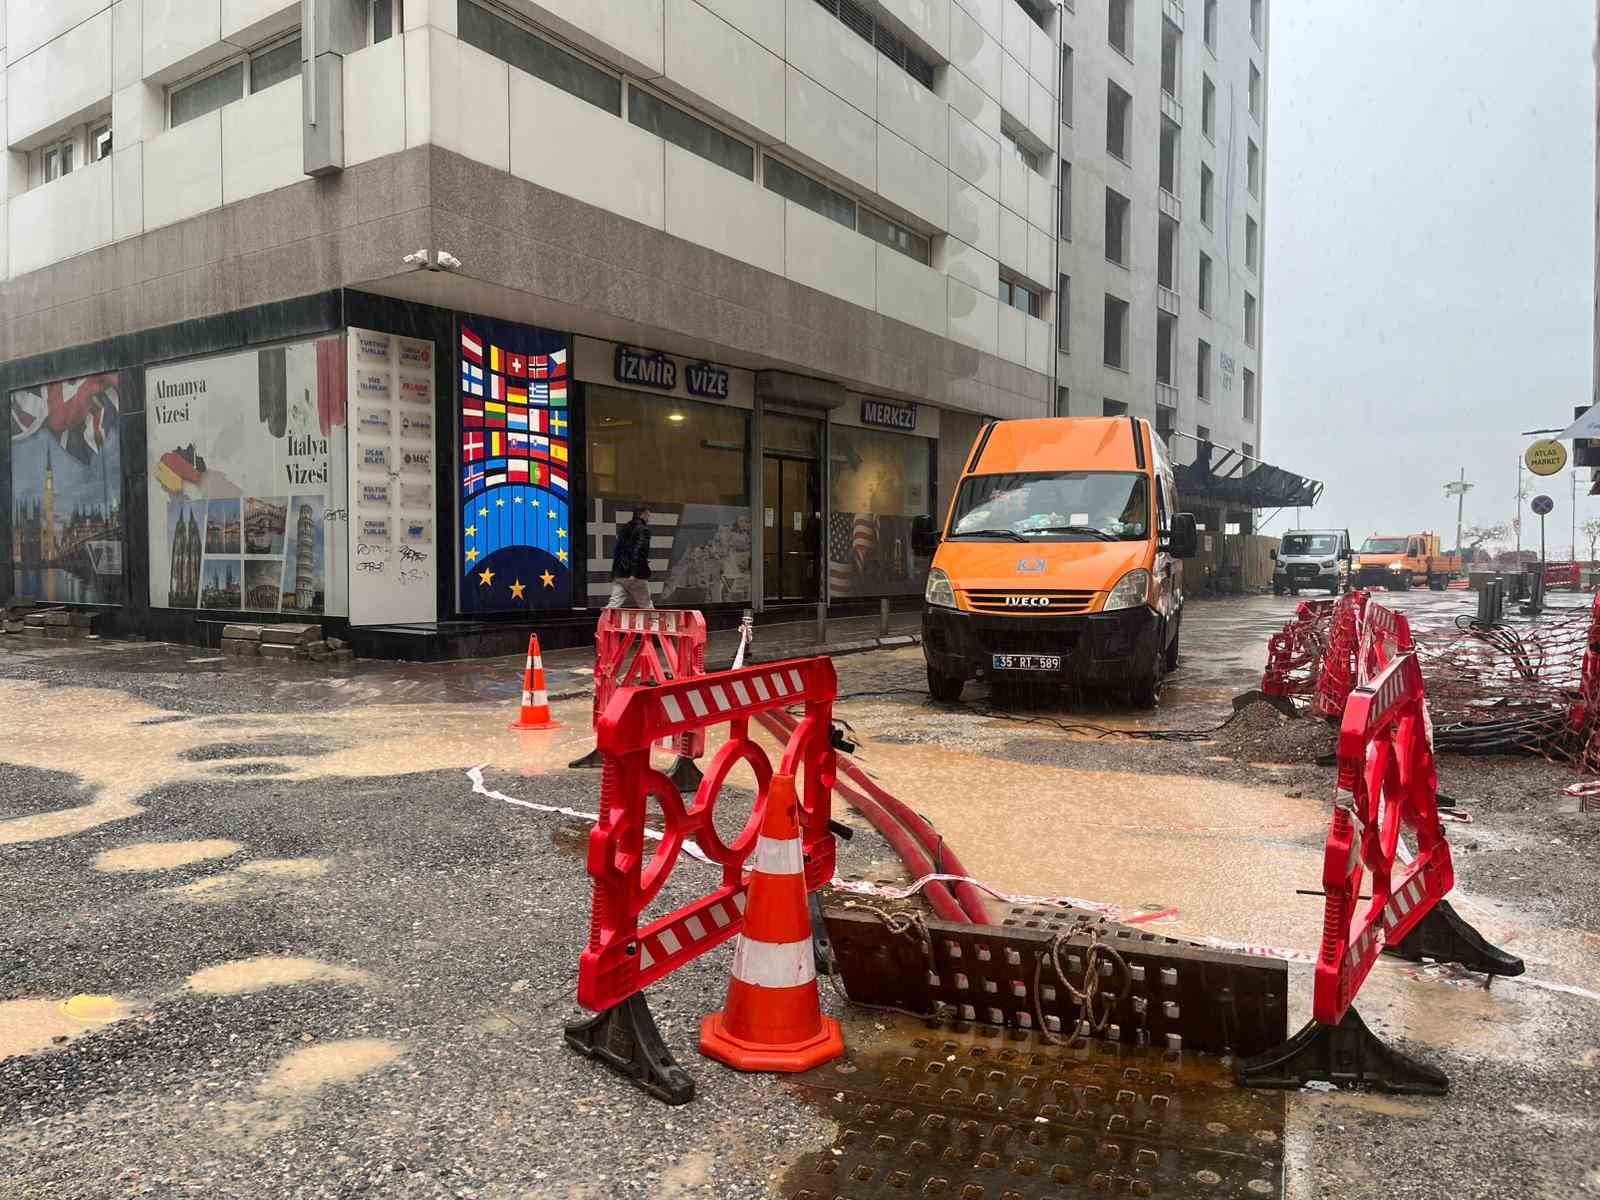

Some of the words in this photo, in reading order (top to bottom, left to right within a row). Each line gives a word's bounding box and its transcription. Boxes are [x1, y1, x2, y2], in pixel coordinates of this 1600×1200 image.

[620, 349, 674, 386] İZMİR
[690, 366, 727, 396] VİZE
[154, 376, 207, 400] Almanya
[154, 403, 190, 425] Vizesi
[864, 403, 916, 429] MERKEZİ
[287, 430, 328, 462] İtalya
[1534, 448, 1557, 457] ATLAS
[1531, 457, 1561, 465] MARKET
[285, 461, 328, 485] Vizesi
[1005, 596, 1050, 607] IVECO
[999, 656, 1013, 667] 35
[1020, 657, 1032, 667] RT
[1039, 658, 1059, 669] 589
